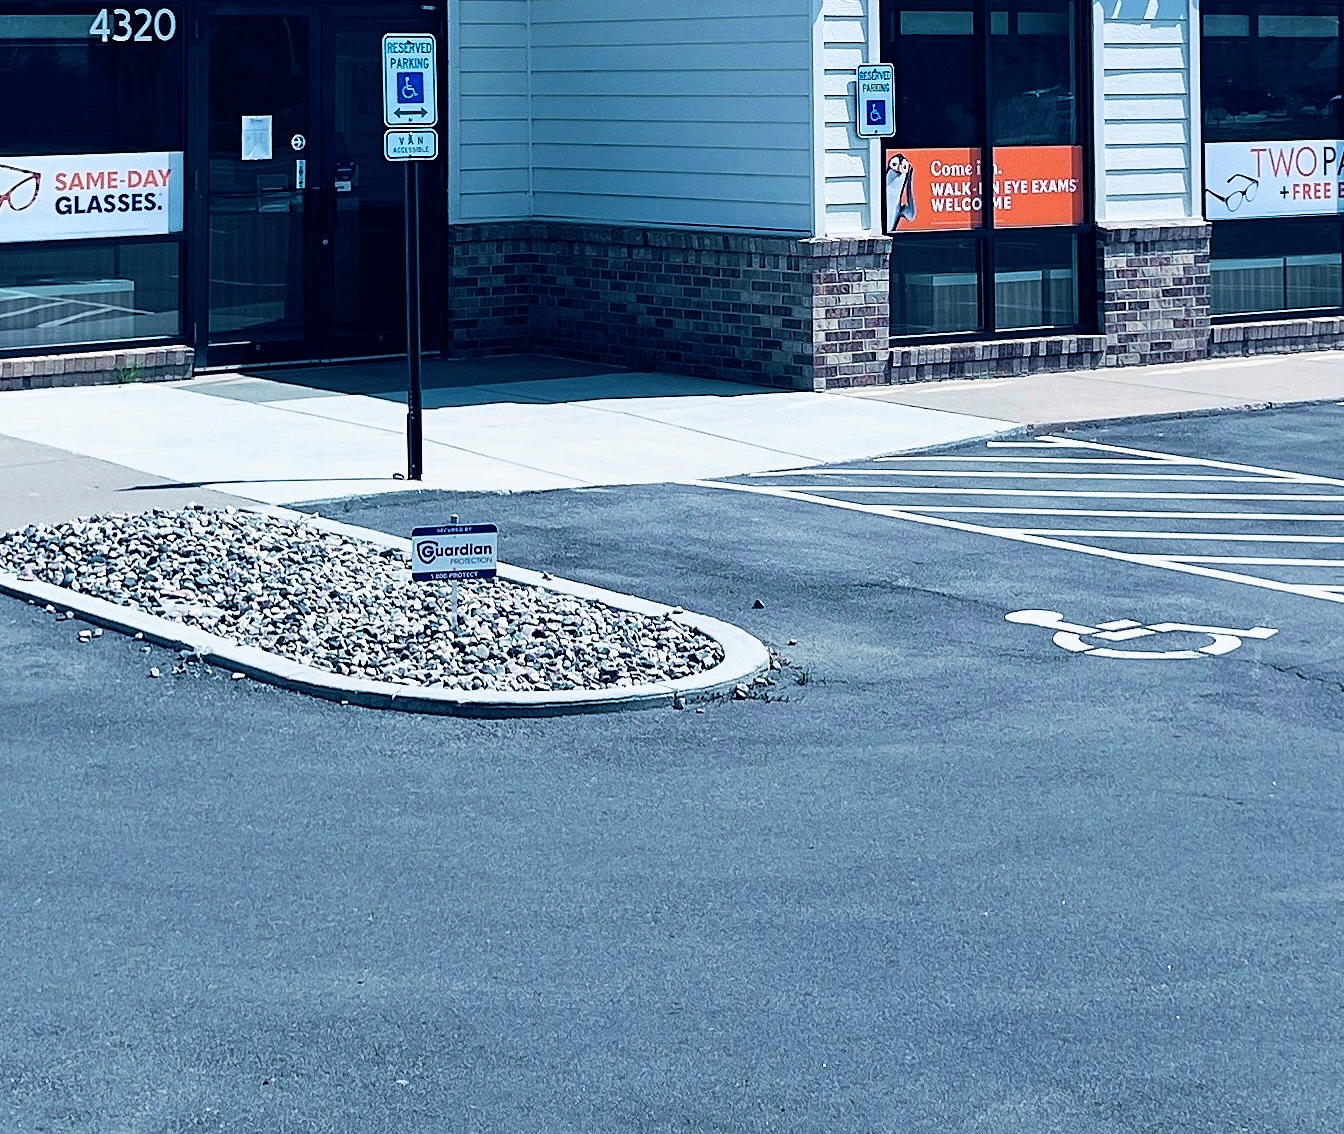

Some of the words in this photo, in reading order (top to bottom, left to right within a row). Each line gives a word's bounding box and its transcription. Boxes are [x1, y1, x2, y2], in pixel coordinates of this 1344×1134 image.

[89, 8, 177, 43] 4320
[387, 42, 432, 54] RESERVED
[390, 57, 430, 69] PARKING
[859, 70, 891, 80] RESERVED
[862, 83, 890, 93] PARKING
[392, 146, 430, 154] ACCESSIBLE
[930, 160, 973, 177] Come
[1250, 146, 1317, 178] TWO
[55, 169, 172, 192] SAME-DAY
[930, 181, 1000, 197] WALK-IN
[1003, 179, 1028, 194] EYE
[55, 193, 163, 216] GLASSES.
[930, 196, 1012, 213] WELCOME
[422, 543, 493, 558] Guardian
[450, 556, 493, 565] PROTECTION
